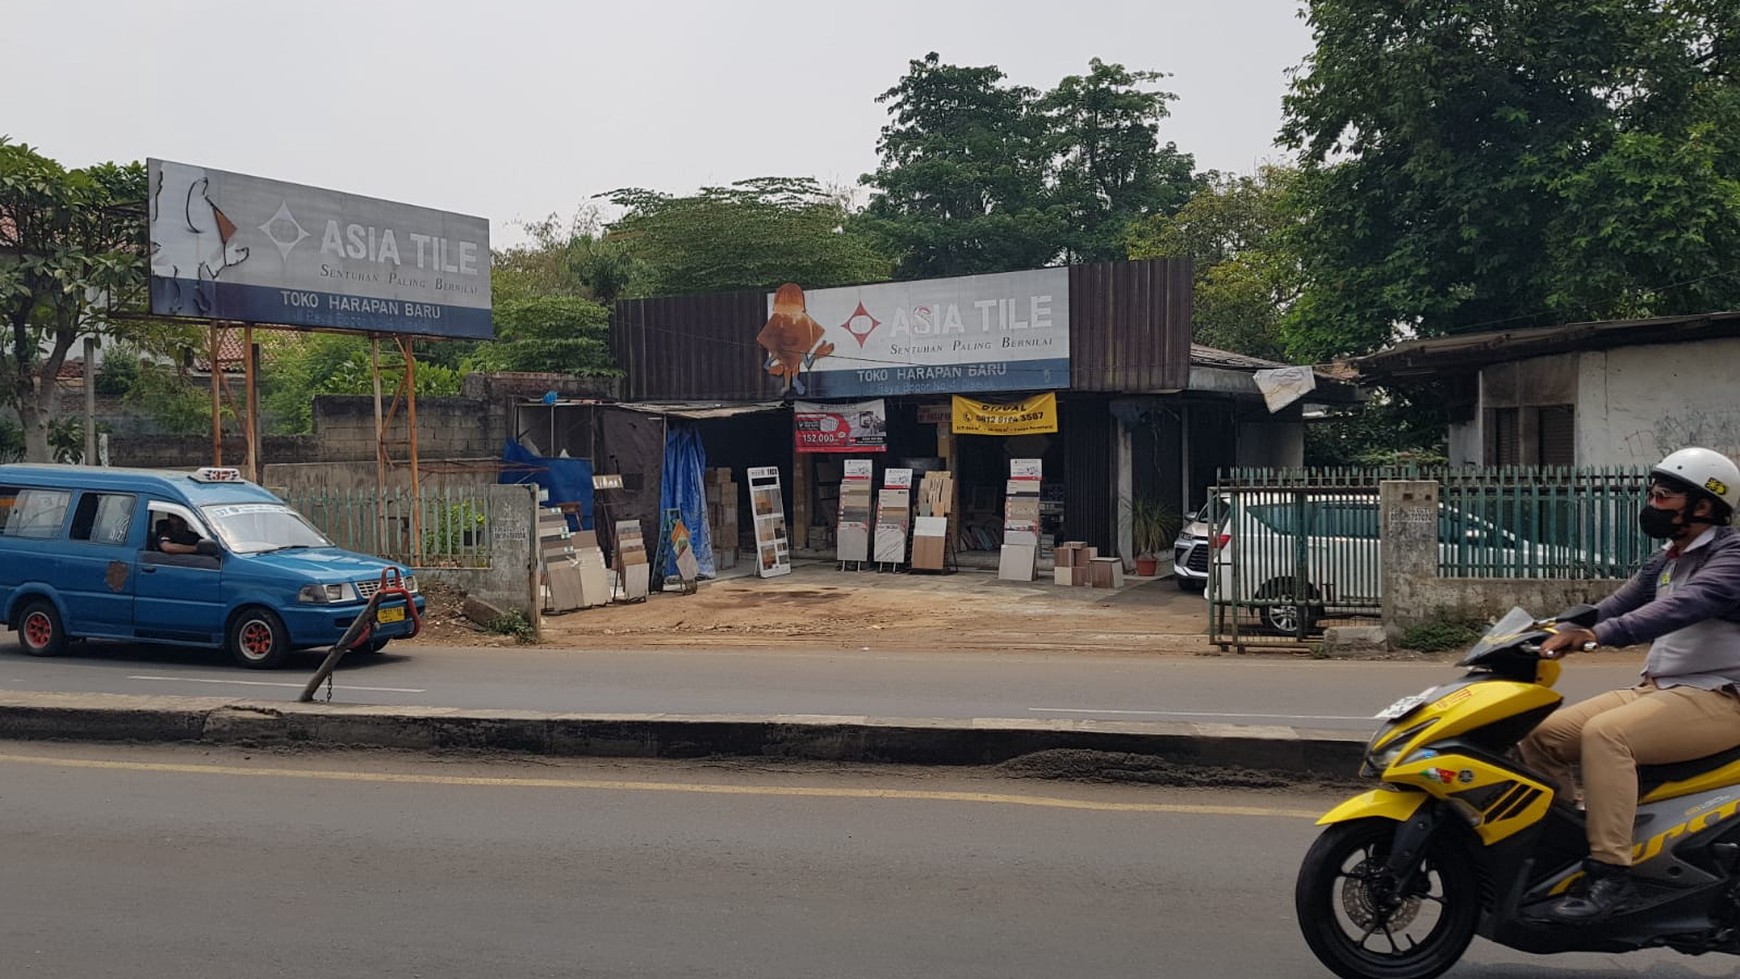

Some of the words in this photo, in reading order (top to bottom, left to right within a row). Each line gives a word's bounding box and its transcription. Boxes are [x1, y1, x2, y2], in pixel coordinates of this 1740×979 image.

[320, 219, 401, 266] ASIA
[409, 233, 478, 276] TILE
[280, 290, 319, 308] TOKO
[329, 295, 399, 316] HARAPAN
[405, 303, 441, 320] BARU
[888, 303, 965, 339] ASIA
[974, 295, 1053, 332] TILE
[857, 368, 888, 383] TOKO
[897, 364, 962, 381] HARAPAN
[968, 362, 1007, 377] BARU
